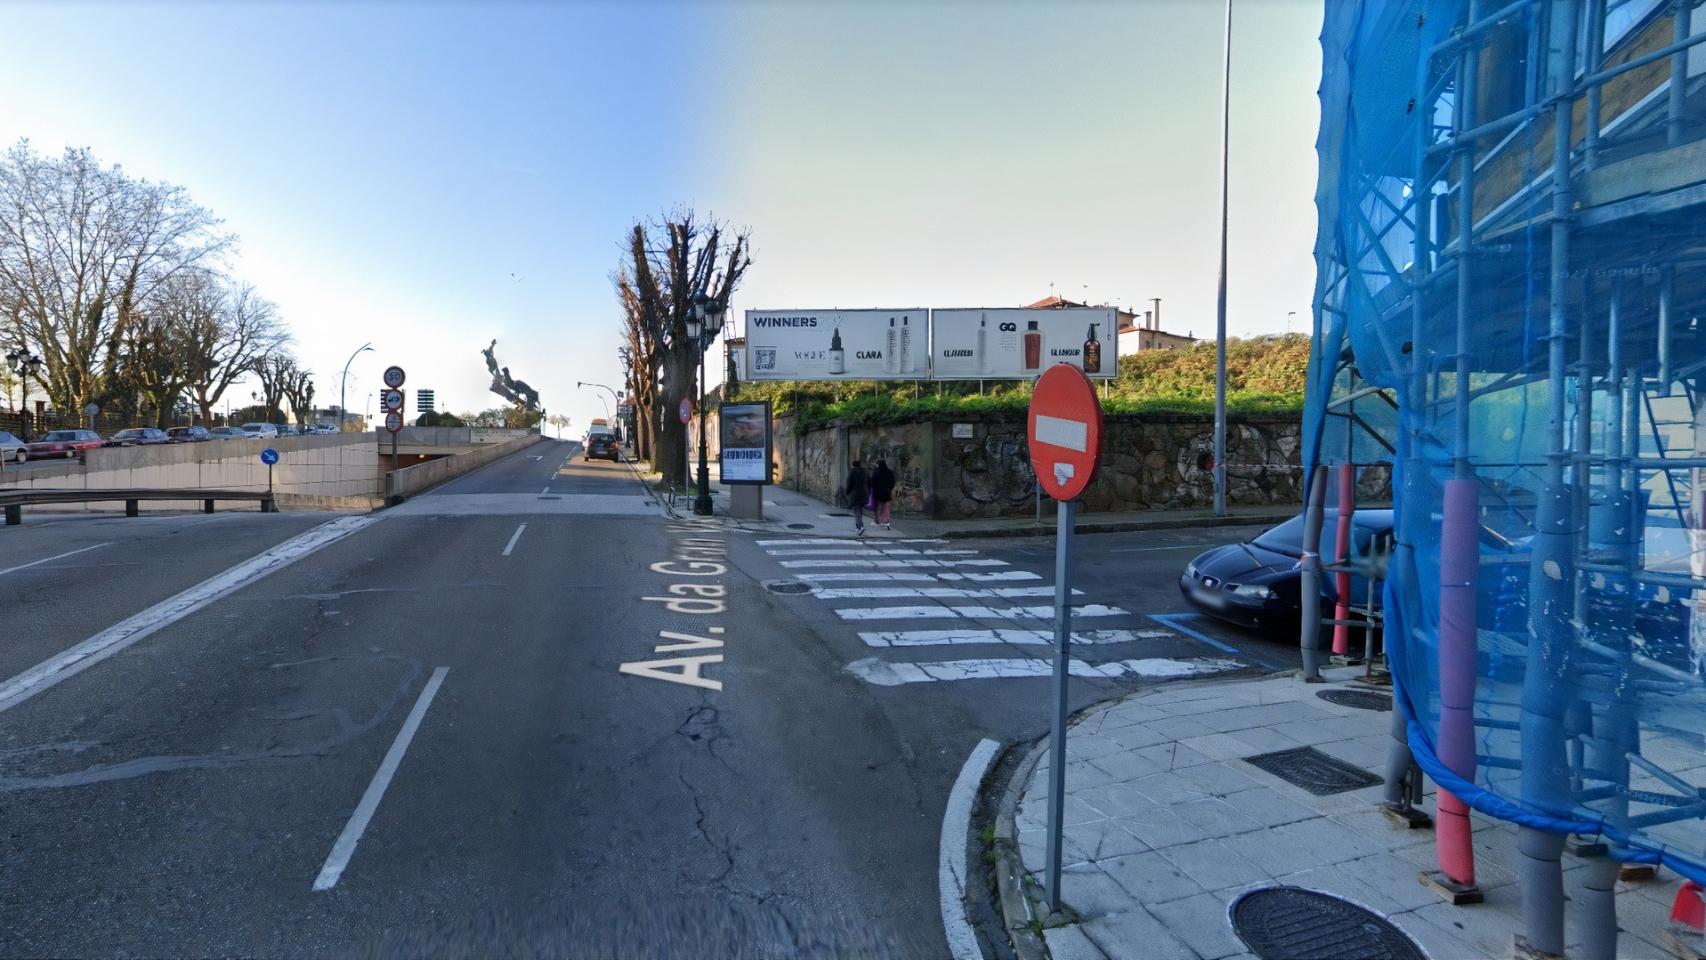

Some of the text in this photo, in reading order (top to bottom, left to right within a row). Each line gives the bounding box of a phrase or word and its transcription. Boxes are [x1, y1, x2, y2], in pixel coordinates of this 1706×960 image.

[754, 317, 818, 328] WINNERS
[999, 322, 1017, 332] GQ
[856, 350, 883, 359] CLARA
